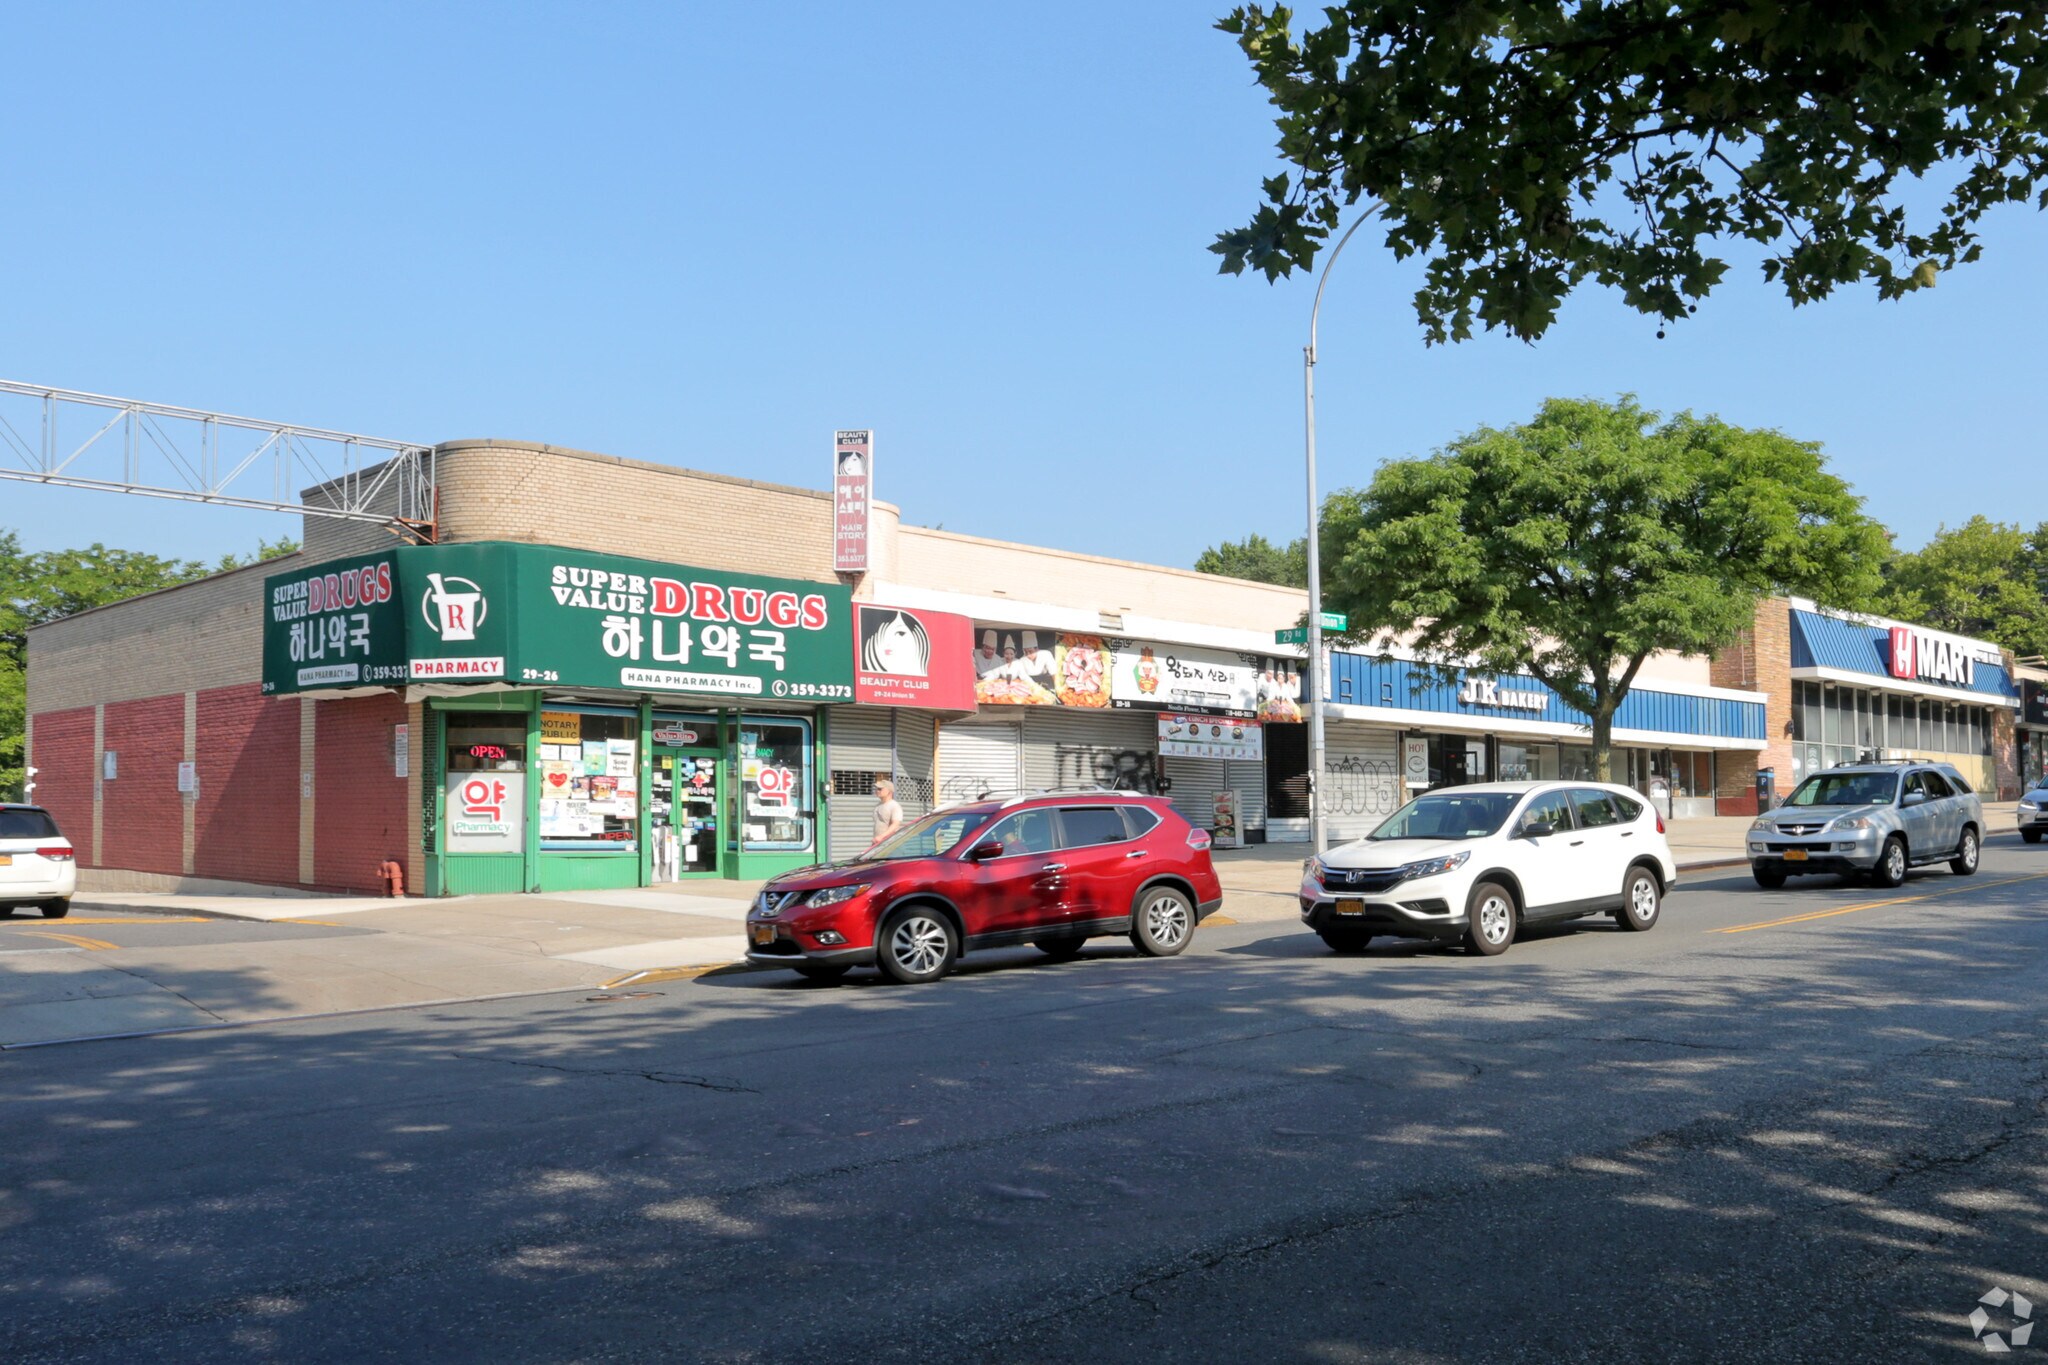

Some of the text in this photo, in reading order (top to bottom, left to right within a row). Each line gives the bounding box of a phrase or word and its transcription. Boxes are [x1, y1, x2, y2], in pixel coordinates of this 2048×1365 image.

[837, 531, 865, 539] STORY
[551, 565, 648, 595] SUPER
[273, 580, 308, 605] SUPER
[307, 561, 392, 615] DRUGS
[550, 586, 645, 614] VALUE
[649, 577, 827, 630] DRUGS
[273, 601, 307, 622] VALUE
[290, 613, 370, 662] 하나약국
[601, 615, 786, 671] 하나약국
[1282, 631, 1292, 642] 29
[1896, 629, 1974, 685] H MART
[414, 660, 498, 674] PHARMACY
[1166, 655, 1203, 679] 왕돼지
[1208, 669, 1228, 682] 신라
[300, 669, 356, 681] HANA PHARMACY Inc.
[522, 668, 558, 682] 29-26
[627, 673, 755, 689] HANA PHARMACY Inc.
[790, 683, 851, 698] 359-3373
[859, 677, 929, 689] BEAUTY CLUB
[1463, 678, 1548, 709] JK BAKERY
[540, 720, 578, 729] NOTARY
[1188, 715, 1208, 723] LUNCH
[540, 730, 577, 739] PUBLIC
[470, 746, 506, 758] OPEN
[1408, 744, 1424, 752] HOT
[760, 769, 792, 806] 약
[1761, 777, 1767, 785] P
[465, 781, 506, 822] 약
[456, 822, 511, 832] Pharmacy
[598, 832, 632, 840] OPEN
